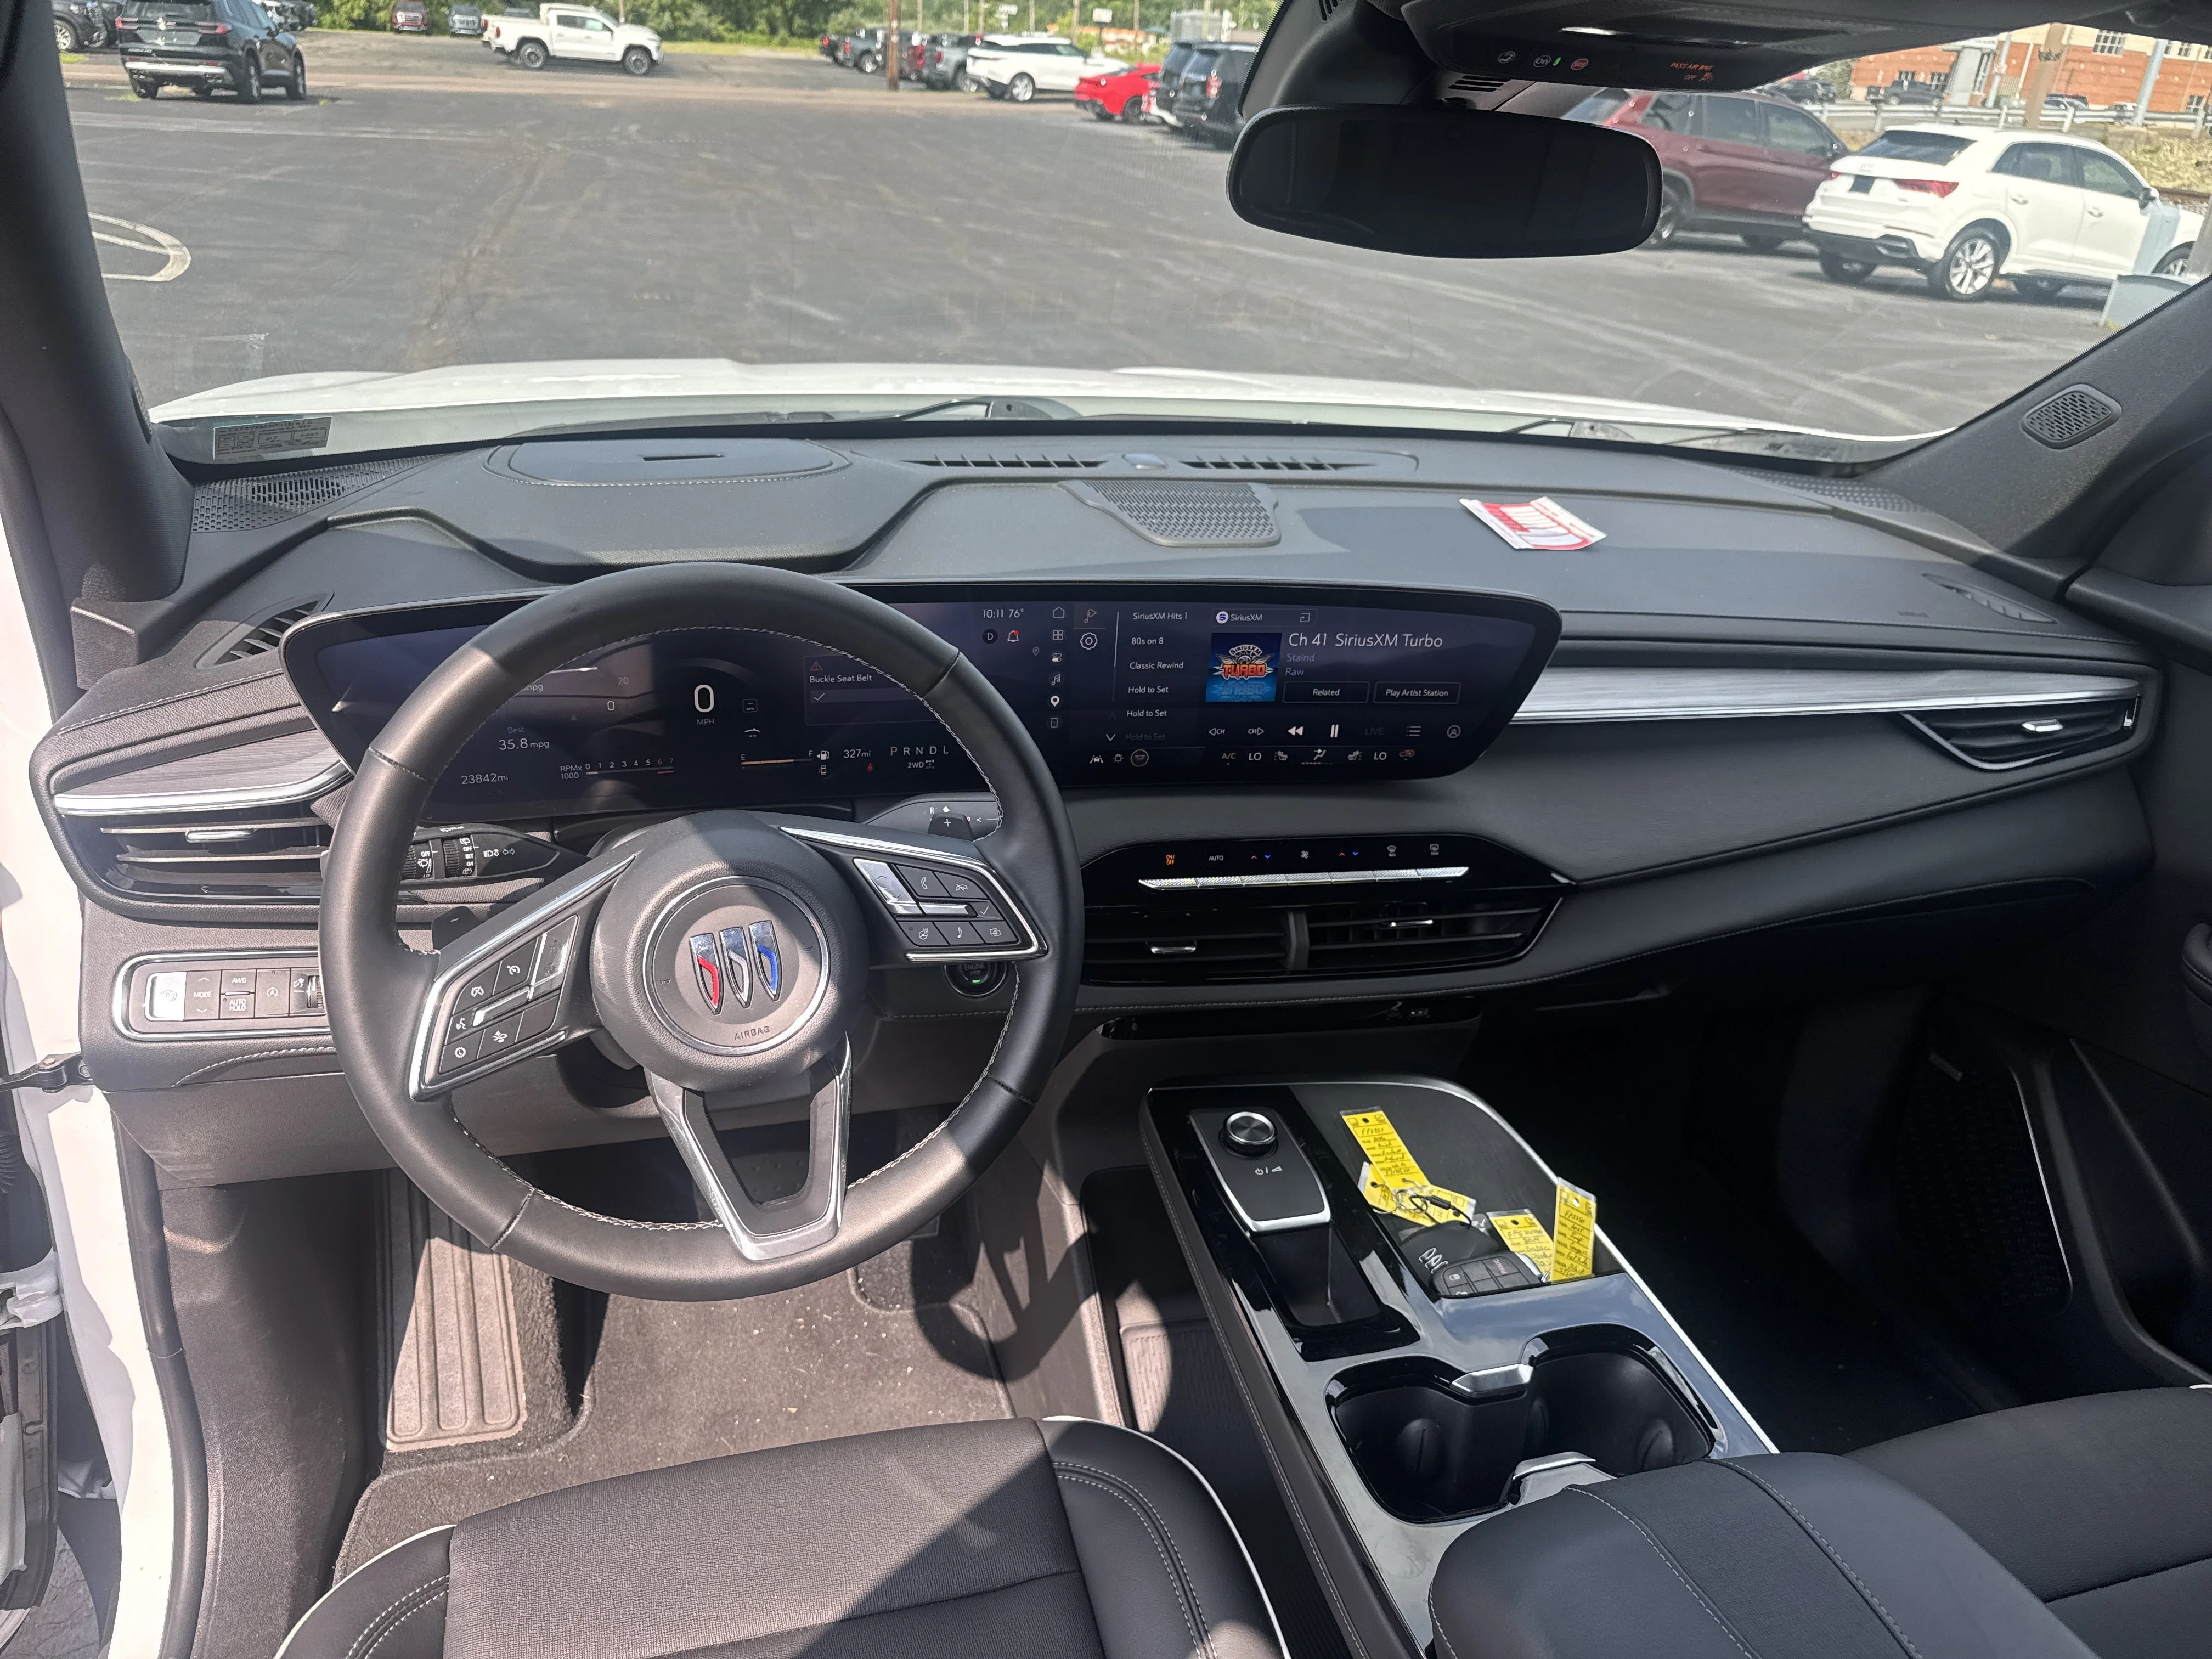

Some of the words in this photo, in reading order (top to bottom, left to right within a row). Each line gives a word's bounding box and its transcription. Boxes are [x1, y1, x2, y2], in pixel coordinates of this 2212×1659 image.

[983, 609, 1004, 618] 10:11
[1132, 612, 1166, 620] SiriusXM
[1167, 612, 1183, 620] Hits
[1131, 637, 1146, 645] 80s
[1158, 637, 1164, 645] 8
[1289, 633, 1308, 647] Ch
[1312, 633, 1327, 647] 41
[1335, 633, 1398, 647] SiriusXM
[1402, 634, 1443, 648] Turbo
[1286, 653, 1316, 663] Staind
[1130, 662, 1155, 670] Classic
[1223, 664, 1266, 678] TURBO
[1285, 667, 1305, 676] Raw
[617, 676, 629, 686] 20
[809, 675, 835, 684] Buckle
[837, 675, 855, 683] Seat
[1312, 689, 1340, 697] Related
[1385, 689, 1400, 698] Play
[693, 684, 715, 713] 0
[507, 726, 526, 734] Best
[1364, 727, 1385, 736] LIVE
[1125, 733, 1143, 741] Hold
[498, 737, 528, 751] 35.8
[529, 740, 550, 751] mpg
[890, 746, 898, 757] P
[903, 746, 911, 756] R
[915, 746, 924, 755] N
[929, 746, 938, 755] D
[943, 745, 949, 755] L
[1221, 752, 1237, 760] A/C
[1248, 752, 1262, 761] LO
[1374, 751, 1387, 761] LO
[645, 758, 651, 766] 5
[561, 771, 579, 780] 1000
[734, 1025, 771, 1041] AIRBAG
[1493, 1259, 1508, 1274] PANIC
